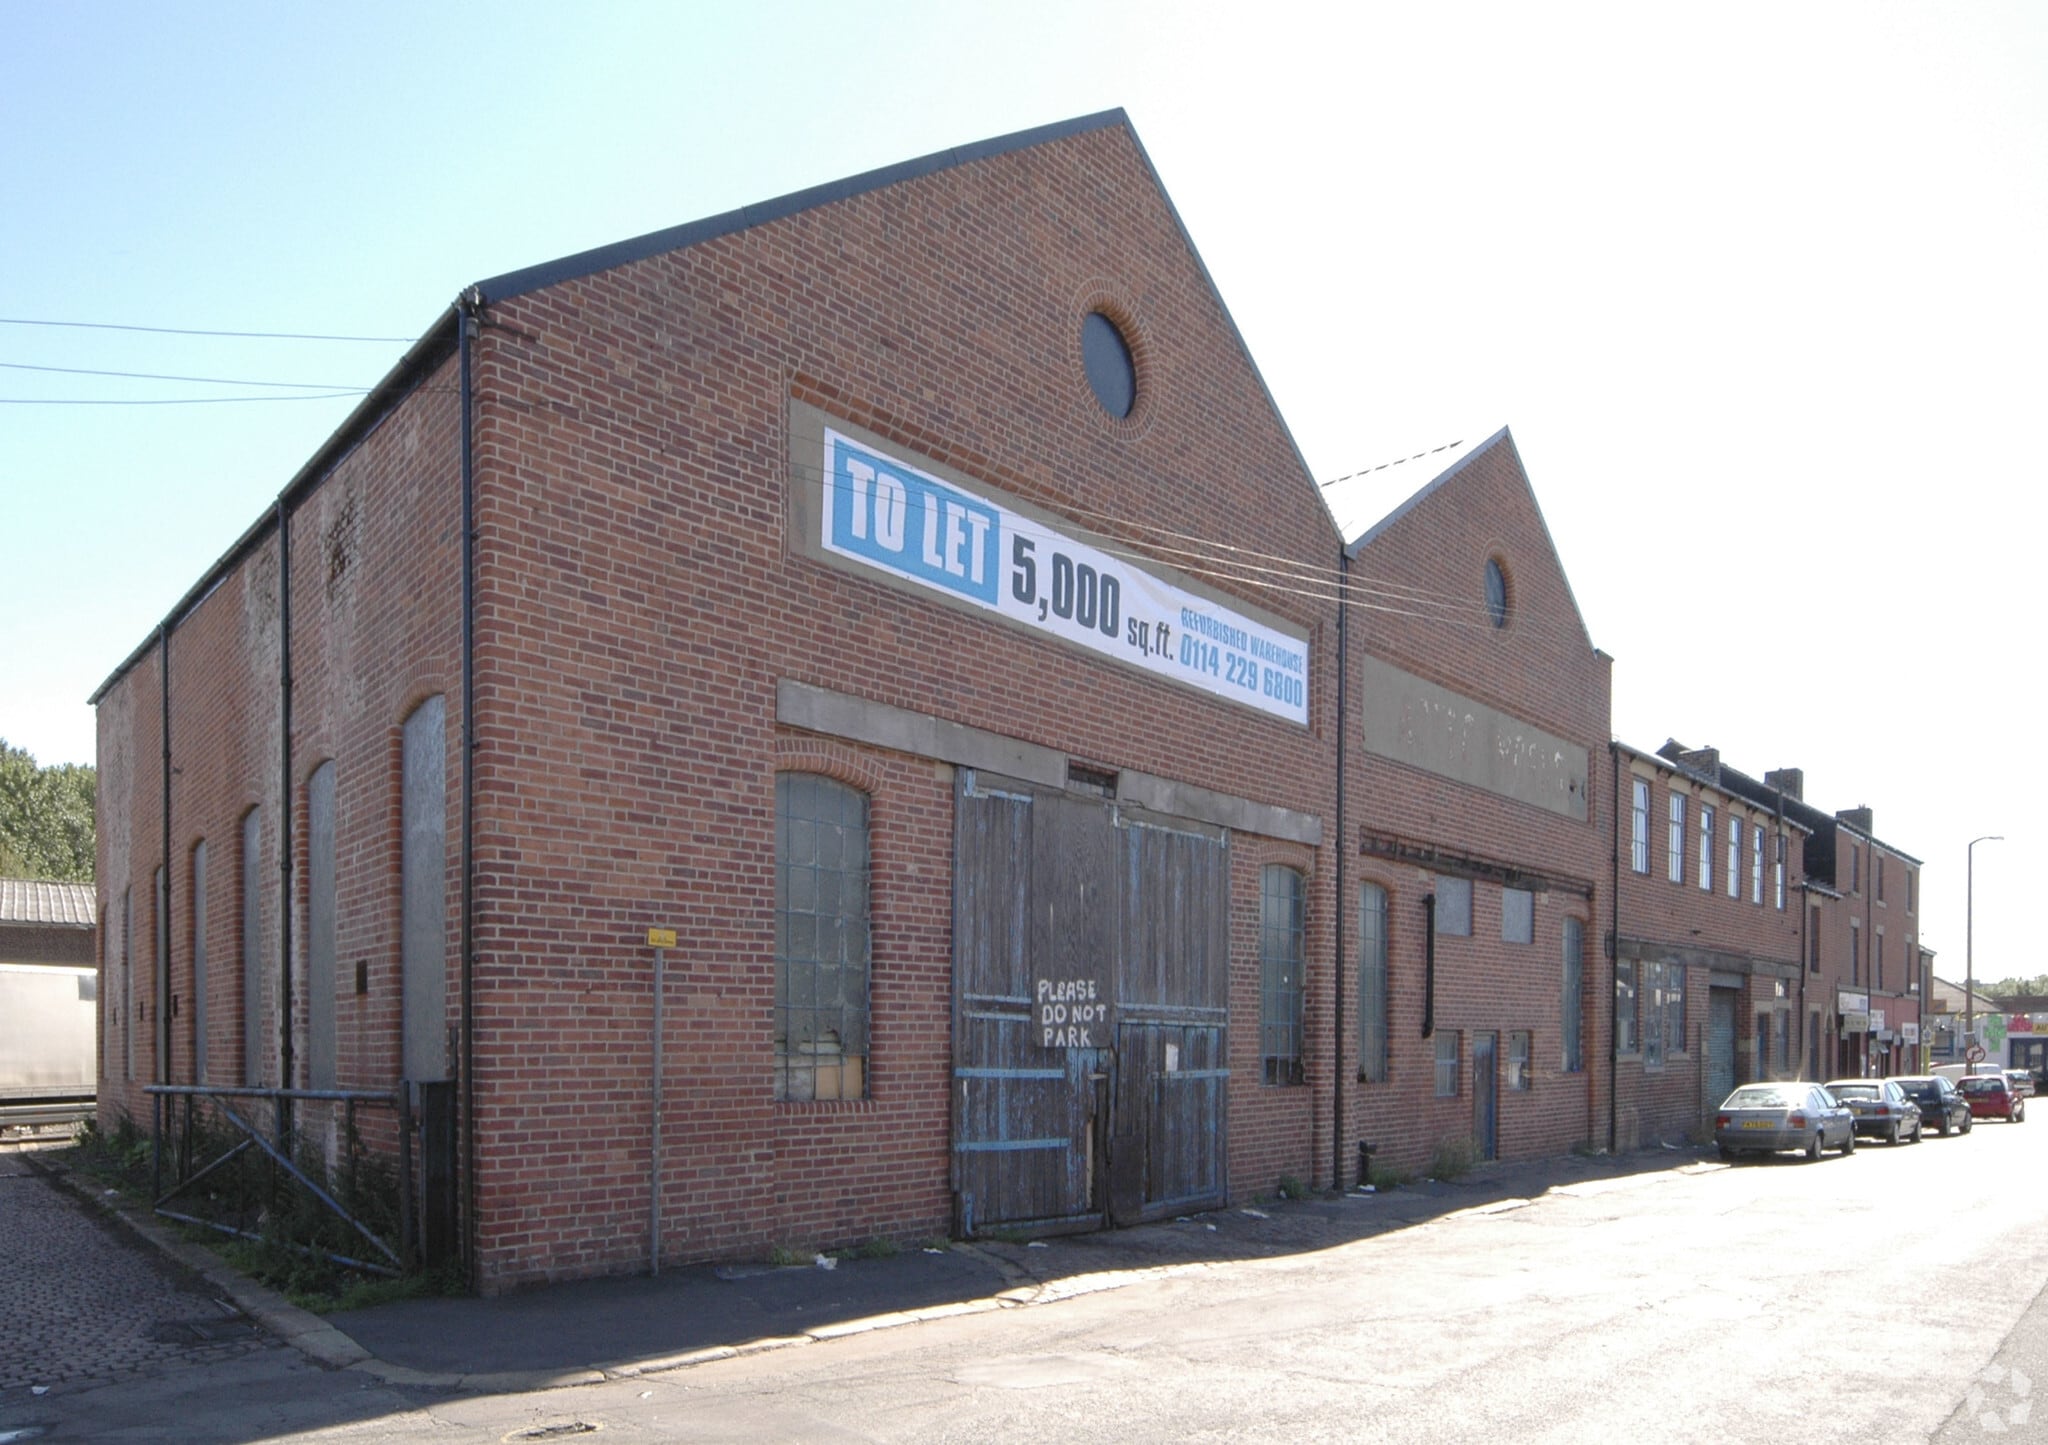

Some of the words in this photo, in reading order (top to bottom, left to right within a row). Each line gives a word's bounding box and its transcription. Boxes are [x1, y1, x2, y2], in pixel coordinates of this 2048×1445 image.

[846, 457, 907, 553] TO
[922, 490, 990, 585] LET
[1012, 533, 1121, 639] 5,000
[1127, 616, 1174, 661] sq.ft.
[1180, 606, 1248, 652] REFURBISHED
[1250, 635, 1303, 675] WAREHOUSE
[1179, 633, 1220, 677] 0114
[1225, 652, 1259, 692] 229
[1263, 667, 1303, 708] 6800
[1037, 979, 1097, 1003] PLEASE
[1041, 1003, 1067, 1025] DO
[1072, 1003, 1107, 1024] NOT
[1043, 1025, 1092, 1048] PARK
